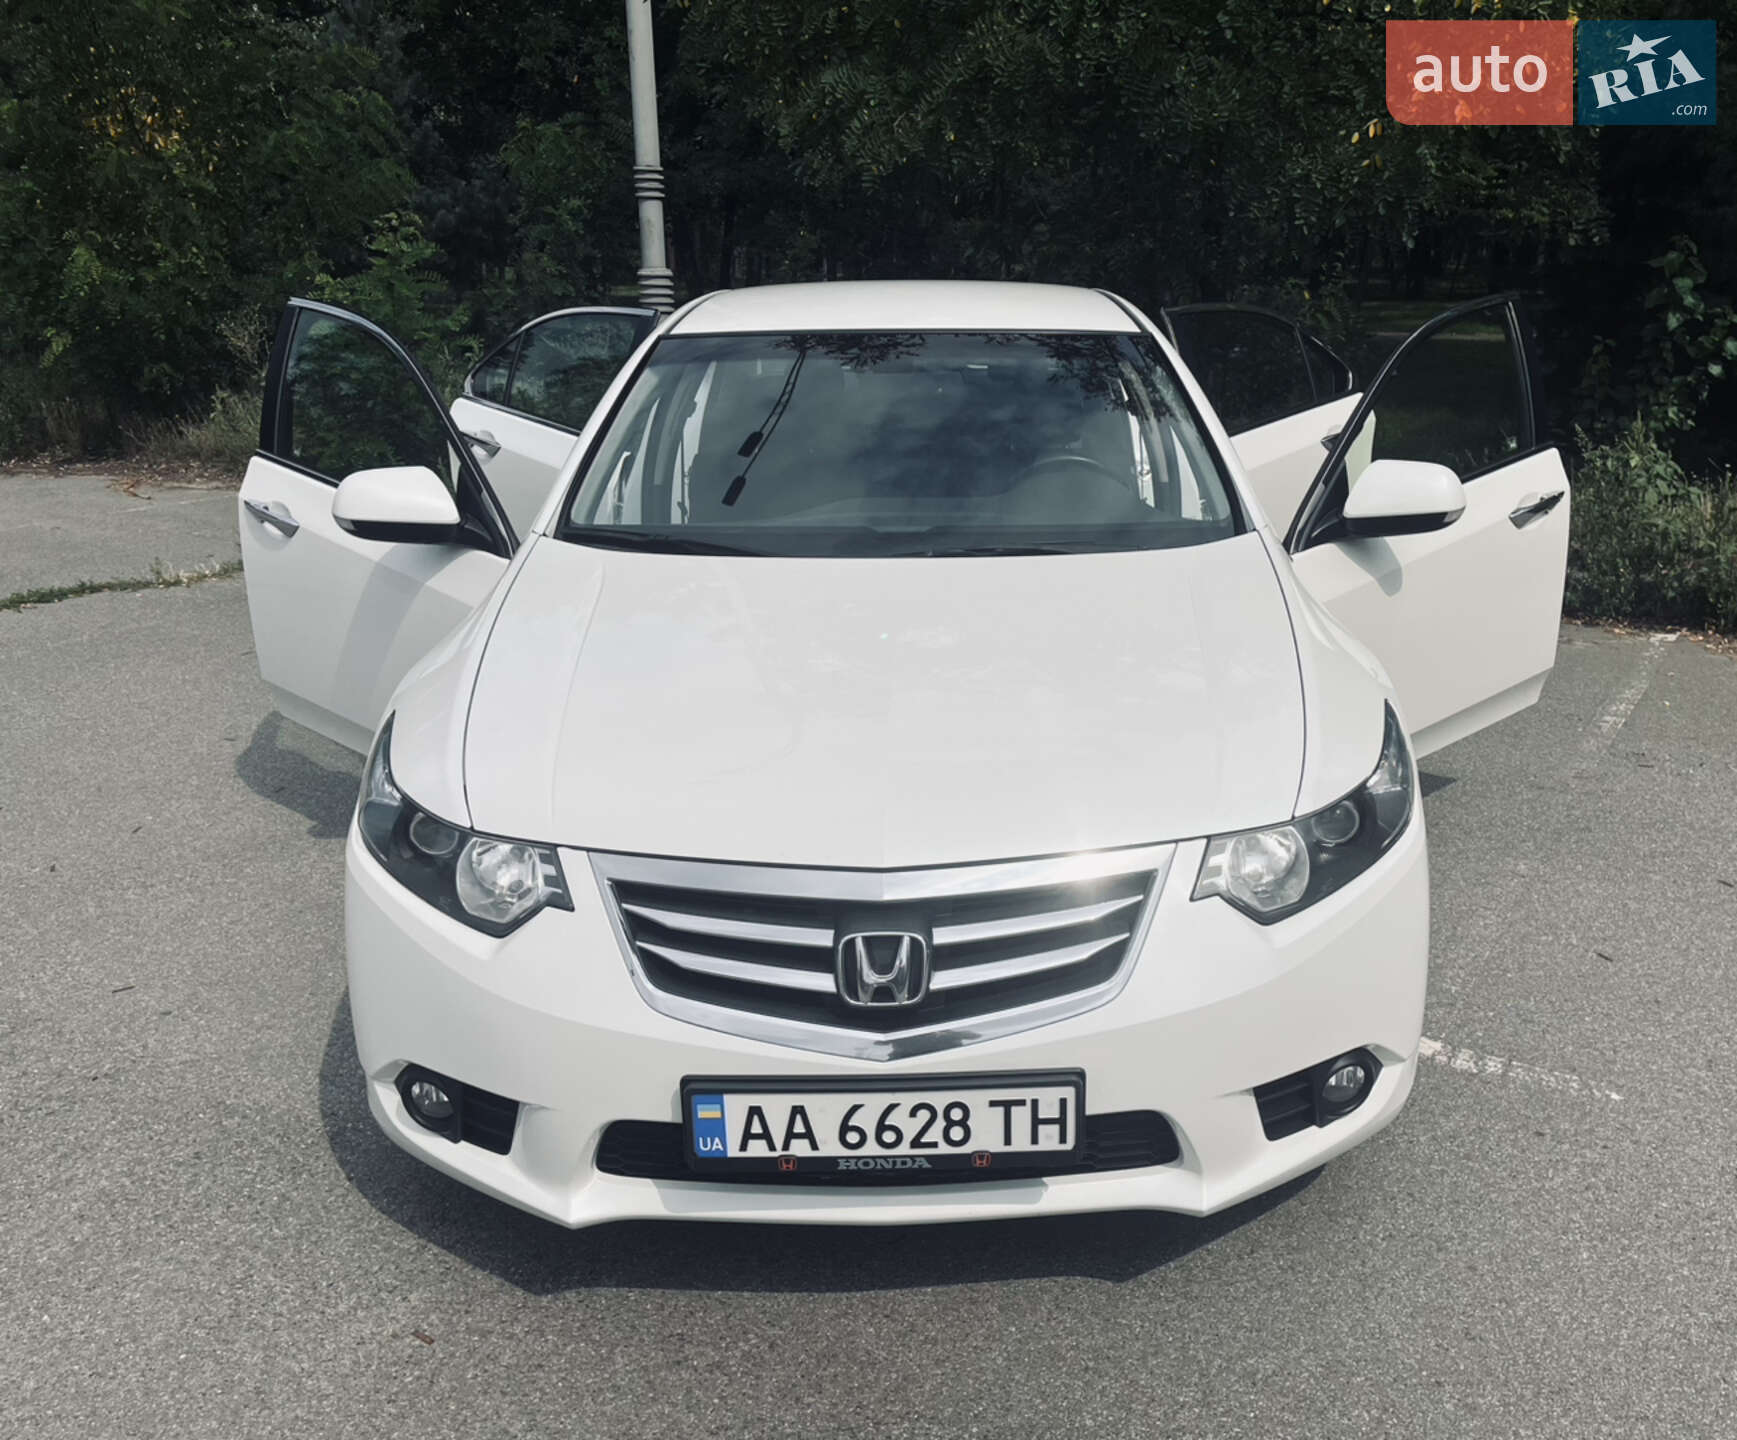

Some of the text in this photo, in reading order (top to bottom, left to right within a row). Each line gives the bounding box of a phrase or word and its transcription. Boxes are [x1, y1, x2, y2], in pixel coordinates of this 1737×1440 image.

[738, 1097, 1068, 1153] AA 6628 TH
[699, 1136, 724, 1152] UA
[836, 1157, 932, 1171] HONDA
